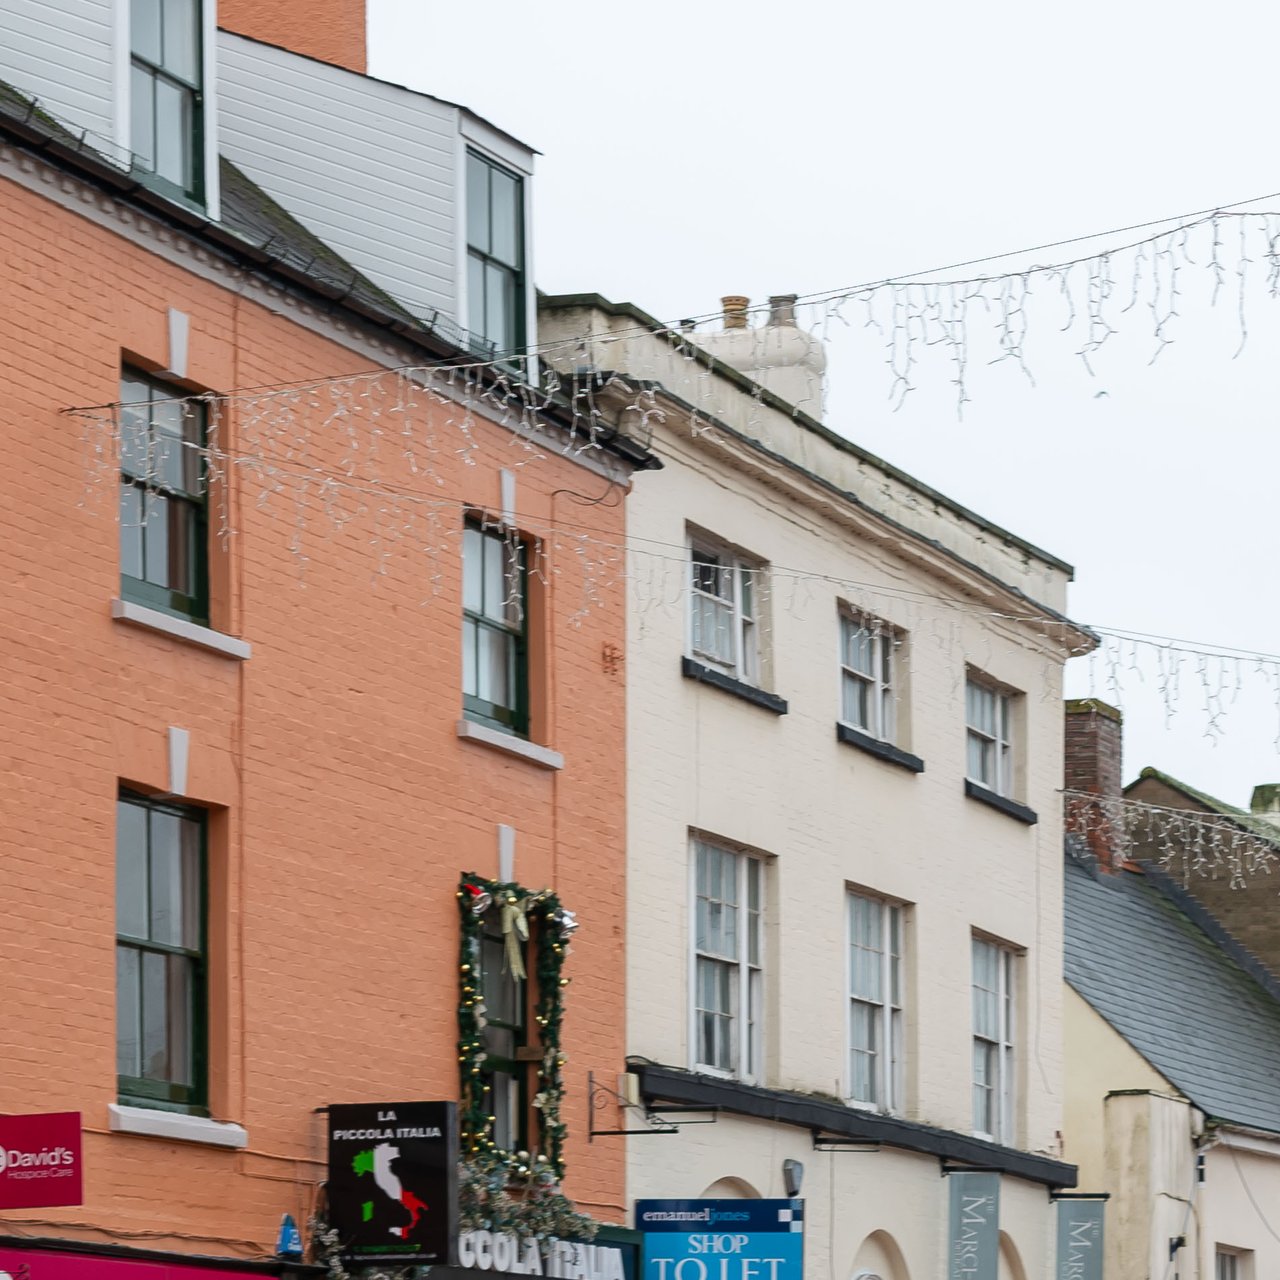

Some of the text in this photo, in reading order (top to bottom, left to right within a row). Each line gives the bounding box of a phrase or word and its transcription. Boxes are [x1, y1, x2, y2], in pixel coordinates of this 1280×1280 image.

[377, 1111, 397, 1121] LA
[333, 1126, 442, 1140] PICCOLA ITALIA
[7, 1146, 75, 1168] David's
[49, 1167, 75, 1177] Care
[688, 1234, 749, 1254] SHOP
